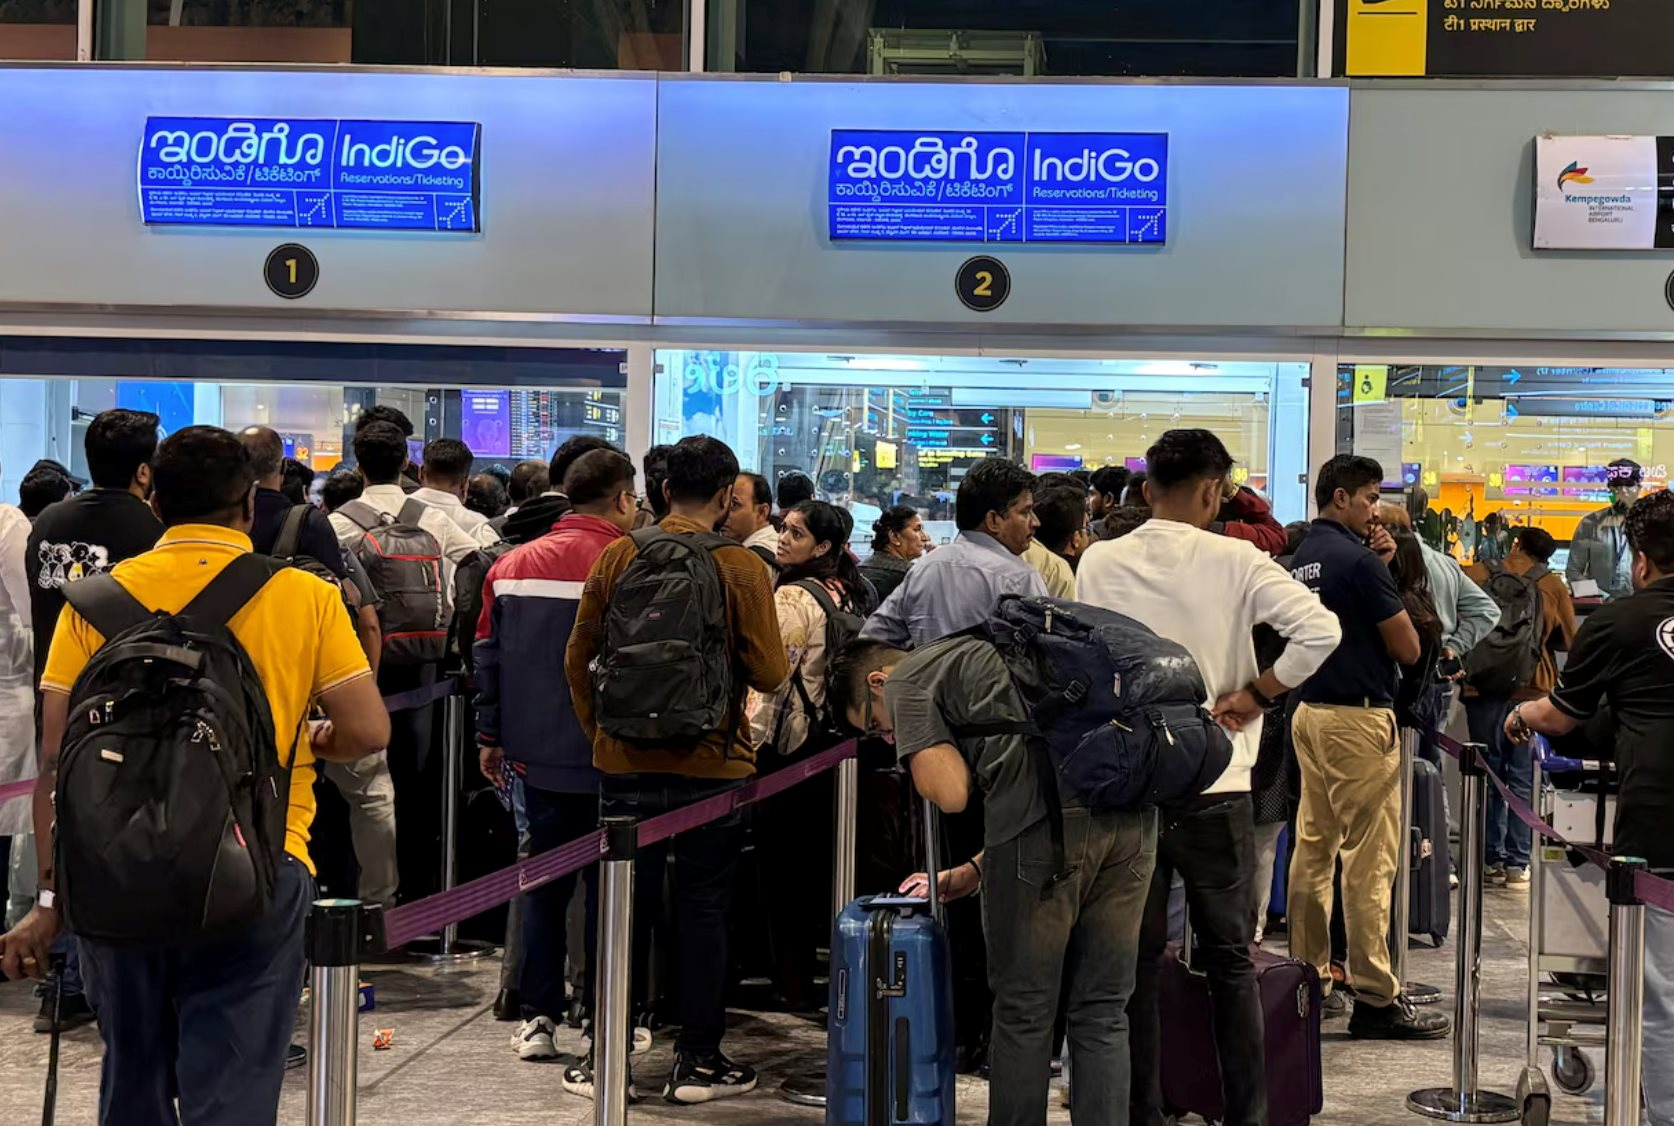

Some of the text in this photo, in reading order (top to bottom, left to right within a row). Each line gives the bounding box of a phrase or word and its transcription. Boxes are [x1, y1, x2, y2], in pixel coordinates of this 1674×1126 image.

[1443, 15, 1537, 33] टी1 प्रस्थान द्वार
[341, 134, 465, 169] IndiGo
[1033, 148, 1159, 182] IndiGo
[340, 171, 464, 189] Reservations/Ticketing
[1033, 186, 1158, 202] Reservations/Ticketing
[1565, 195, 1631, 205] Kempegowda
[285, 258, 297, 283] 1
[973, 271, 992, 296] 2
[1290, 562, 1321, 581] ORTER
